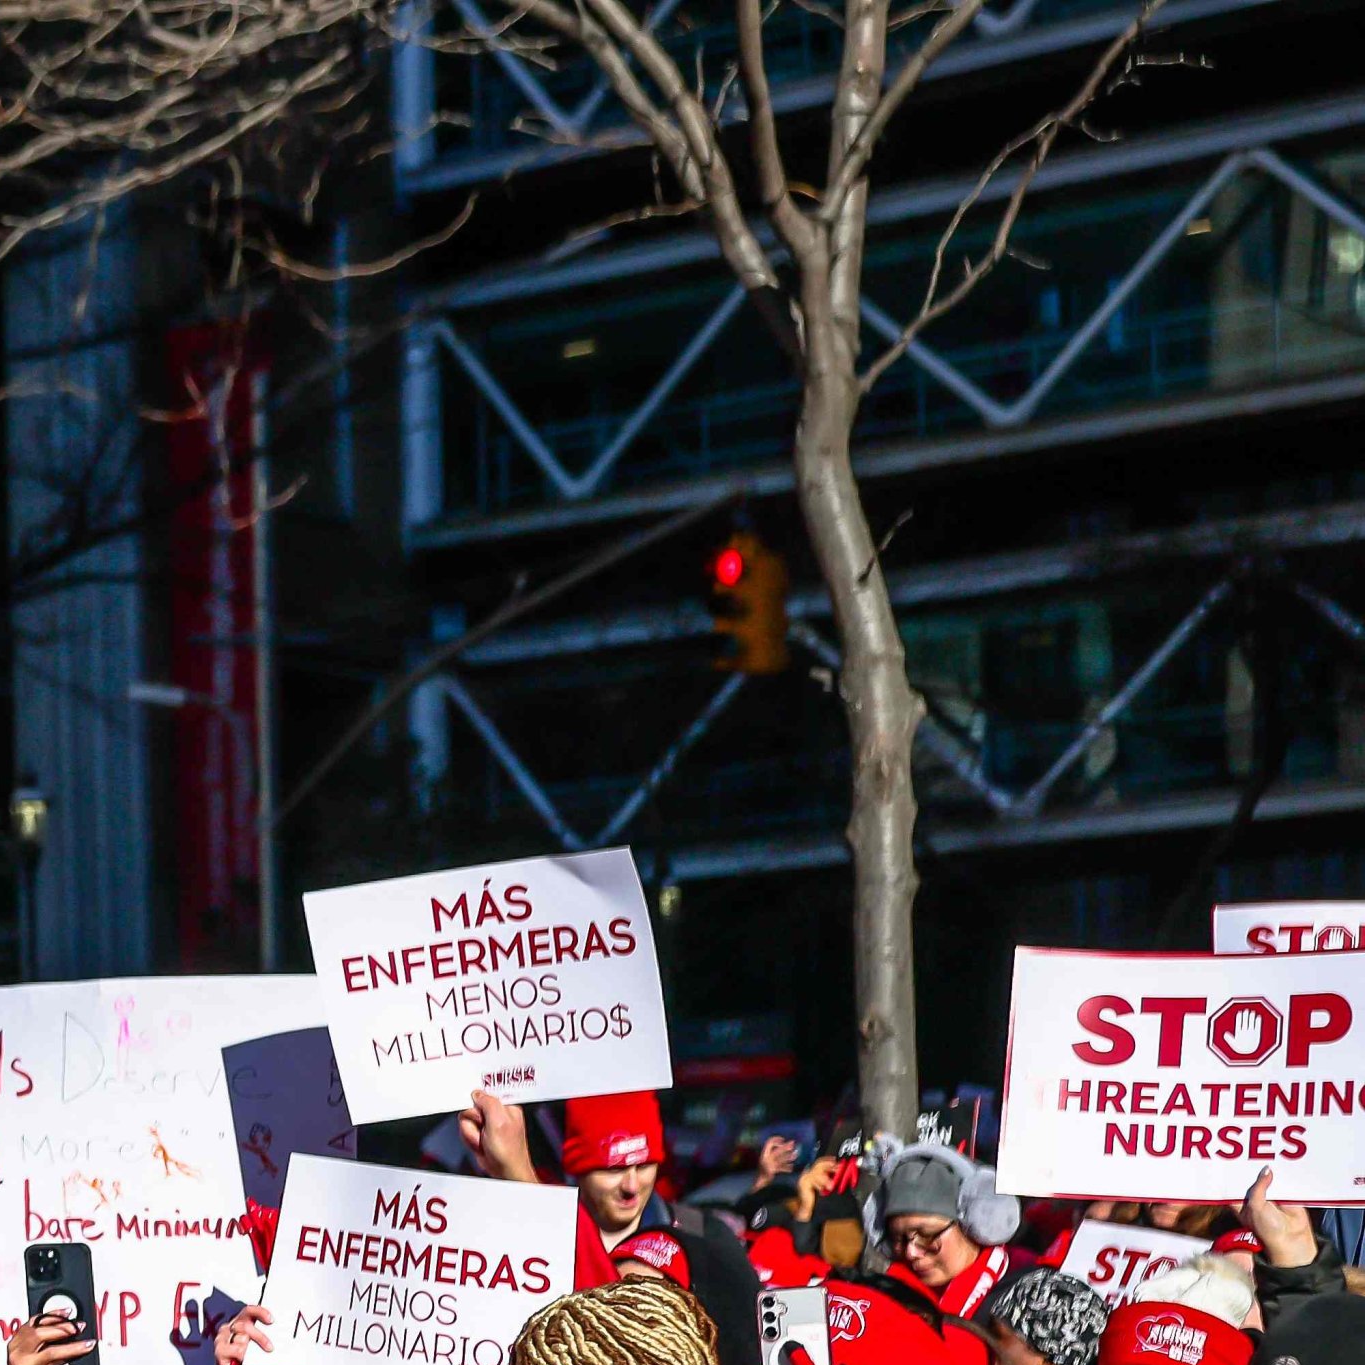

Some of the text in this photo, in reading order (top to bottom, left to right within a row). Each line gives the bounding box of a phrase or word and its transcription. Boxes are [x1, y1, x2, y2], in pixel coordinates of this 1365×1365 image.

[430, 877, 534, 933] MÁS
[341, 916, 637, 994] ENFERMERAS
[425, 974, 562, 1022] MENOS
[371, 1003, 633, 1069] MILLONARIO$
[1071, 991, 1354, 1069] STOP
[1103, 1122, 1308, 1162] NURSES
[23, 1177, 106, 1242] bare
[372, 1183, 449, 1234] MÁS
[296, 1225, 553, 1294] ENFERMERAS
[348, 1279, 458, 1326] MENOS
